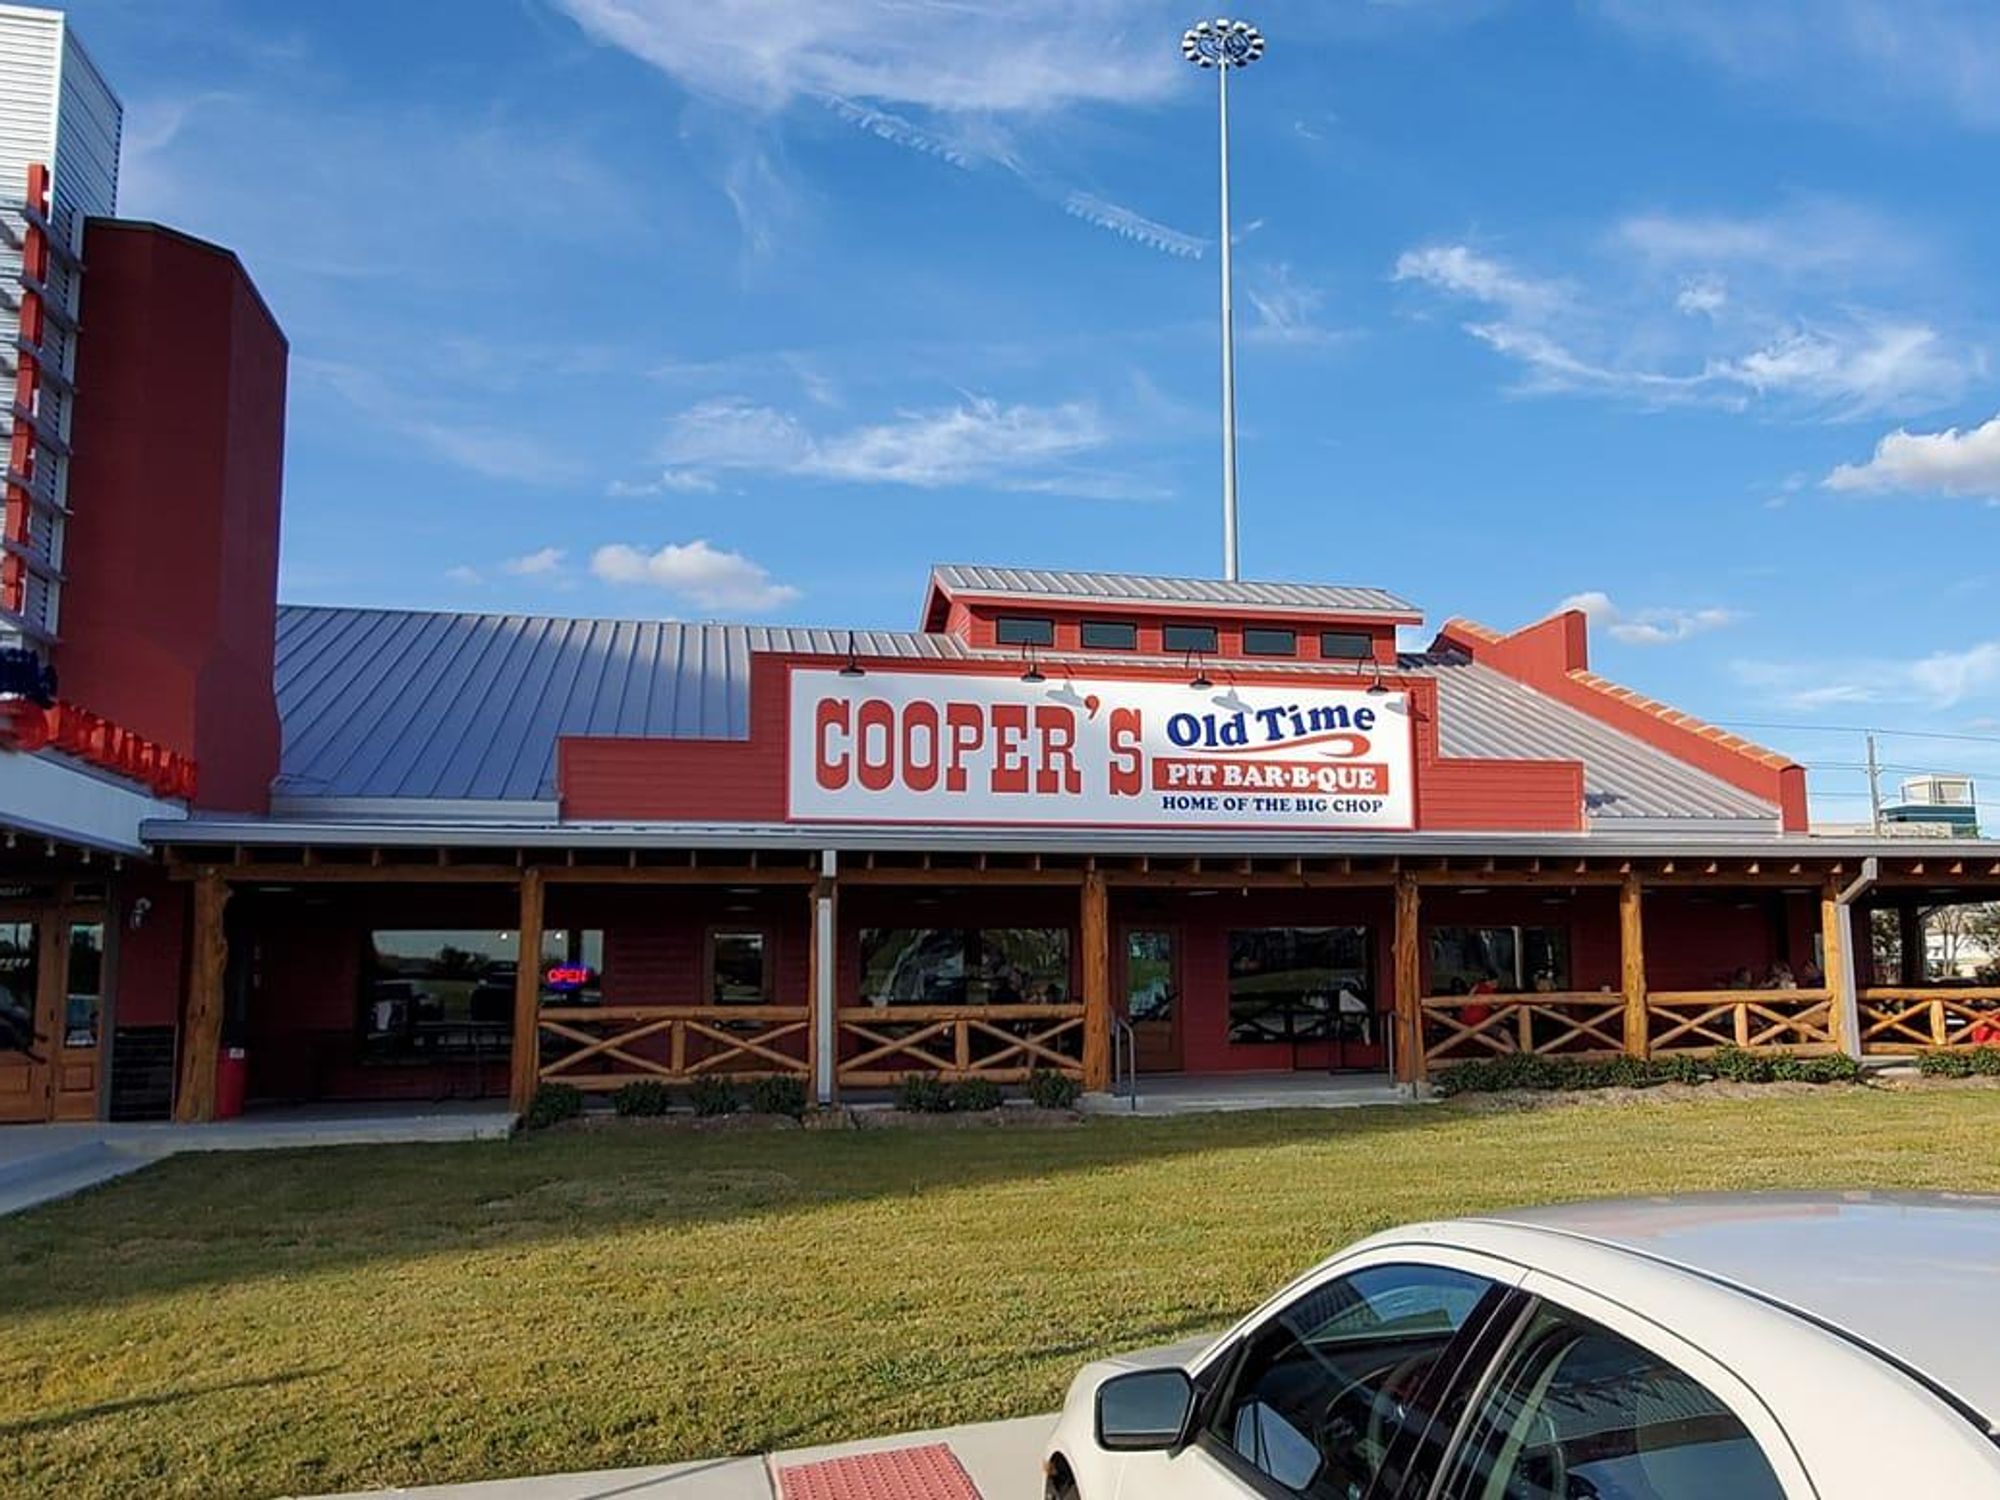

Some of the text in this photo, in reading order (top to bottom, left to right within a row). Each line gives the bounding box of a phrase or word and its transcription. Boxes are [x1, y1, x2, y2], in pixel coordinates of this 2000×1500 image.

[1167, 704, 1376, 747] Old Time
[816, 695, 1143, 796] COOPER'S
[1167, 763, 1217, 786] PIT
[1162, 796, 1383, 813] HOME OF THE BIG CHOP
[547, 968, 588, 983] OPEN
